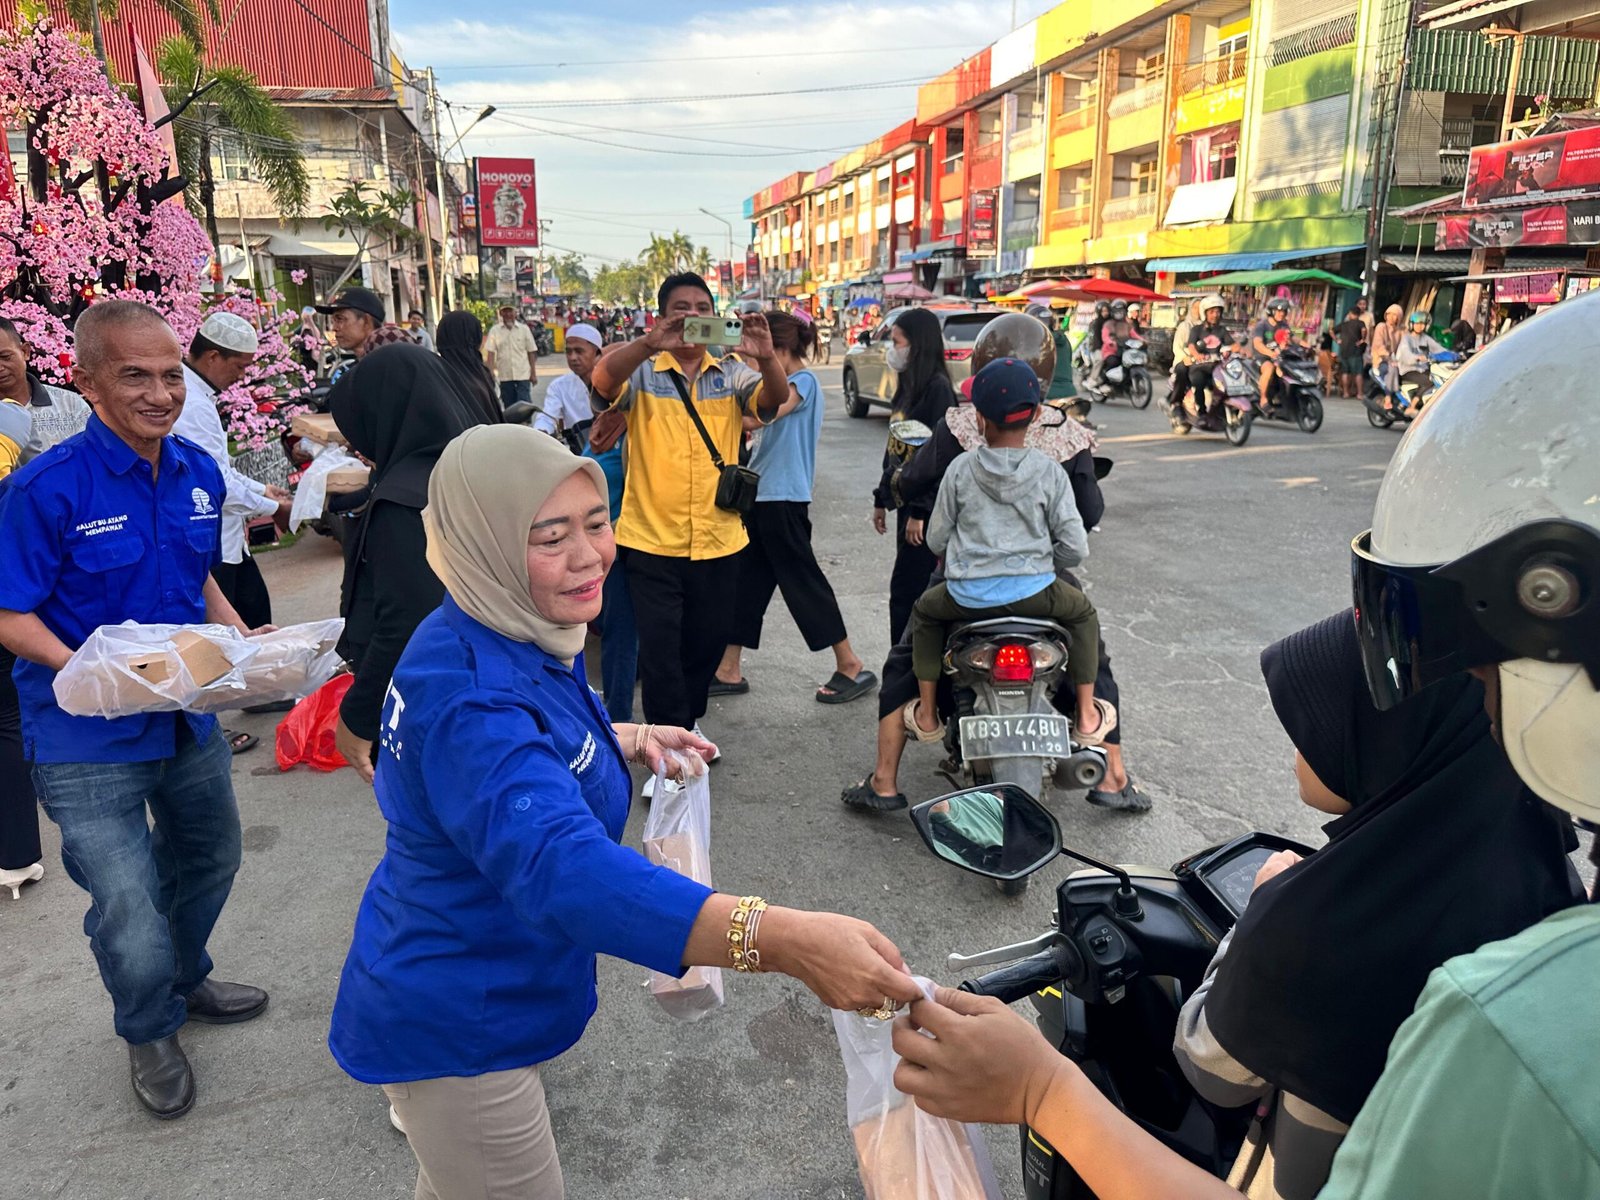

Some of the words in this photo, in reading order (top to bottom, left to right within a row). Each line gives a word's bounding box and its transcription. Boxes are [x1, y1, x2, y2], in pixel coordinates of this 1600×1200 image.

[1511, 151, 1554, 165] FILTER
[1518, 162, 1545, 171] BLACK
[481, 172, 532, 183] MOMOYO
[1475, 221, 1514, 231] FILTER
[1573, 215, 1593, 226] HARI
[85, 523, 124, 537] MEMPAWAH
[1026, 1158, 1050, 1187] GT
